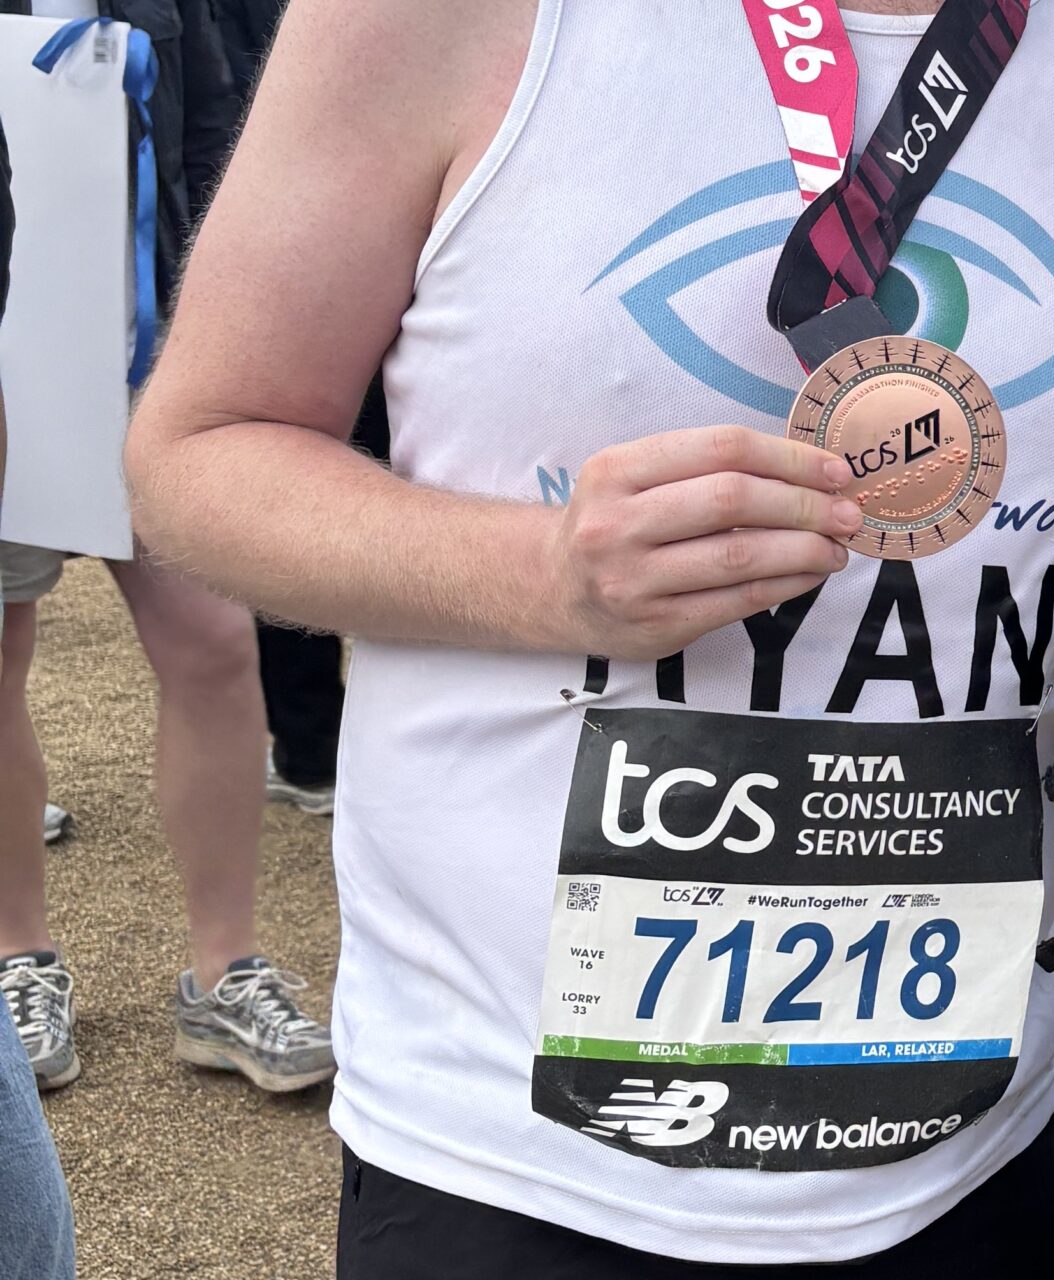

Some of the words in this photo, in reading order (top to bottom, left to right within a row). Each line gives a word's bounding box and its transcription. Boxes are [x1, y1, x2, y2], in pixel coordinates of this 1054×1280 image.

[886, 113, 937, 175] tcs
[844, 440, 898, 479] tcs
[807, 754, 905, 782] TATA
[600, 739, 778, 855] tcs
[801, 788, 1021, 820] CONSULTANCY
[795, 829, 945, 857] SERVICES
[663, 886, 691, 902] tcs
[747, 895, 869, 910] #WeRunTogether
[570, 947, 605, 960] WAVE
[579, 960, 593, 970] 16
[633, 918, 961, 1024] 71218
[561, 992, 601, 1005] LORRY
[573, 1005, 587, 1016] 33
[638, 1043, 689, 1057] MEDAL
[861, 1043, 891, 1058] LAR,
[894, 1042, 955, 1056] RELAXED
[728, 1126, 808, 1151] new
[815, 1110, 962, 1150] balance
